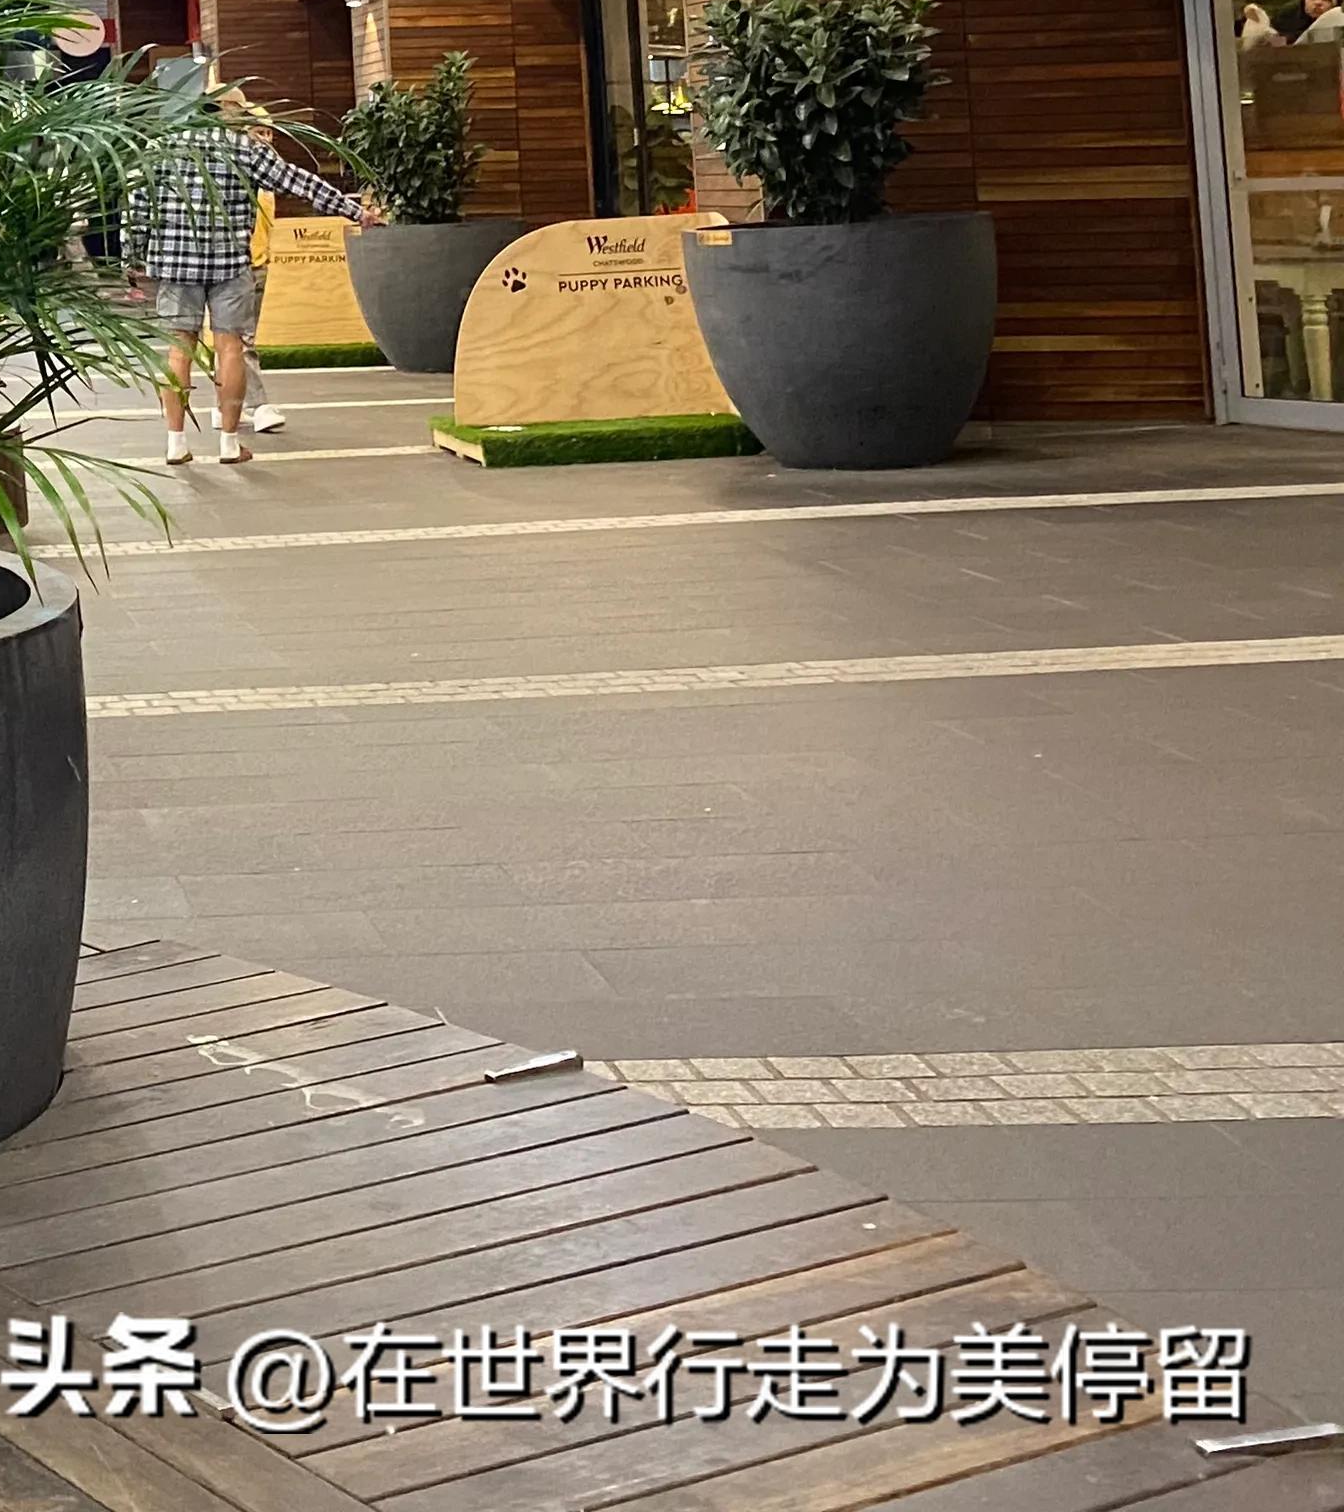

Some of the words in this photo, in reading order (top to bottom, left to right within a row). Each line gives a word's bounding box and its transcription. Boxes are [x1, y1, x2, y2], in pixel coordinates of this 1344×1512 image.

[586, 236, 647, 255] Westfield
[274, 255, 306, 264] PUPPY
[308, 255, 346, 263] PARKIN
[593, 257, 644, 267] CHATSWOOD
[559, 278, 609, 293] PUPPY
[614, 274, 684, 290] PARKING
